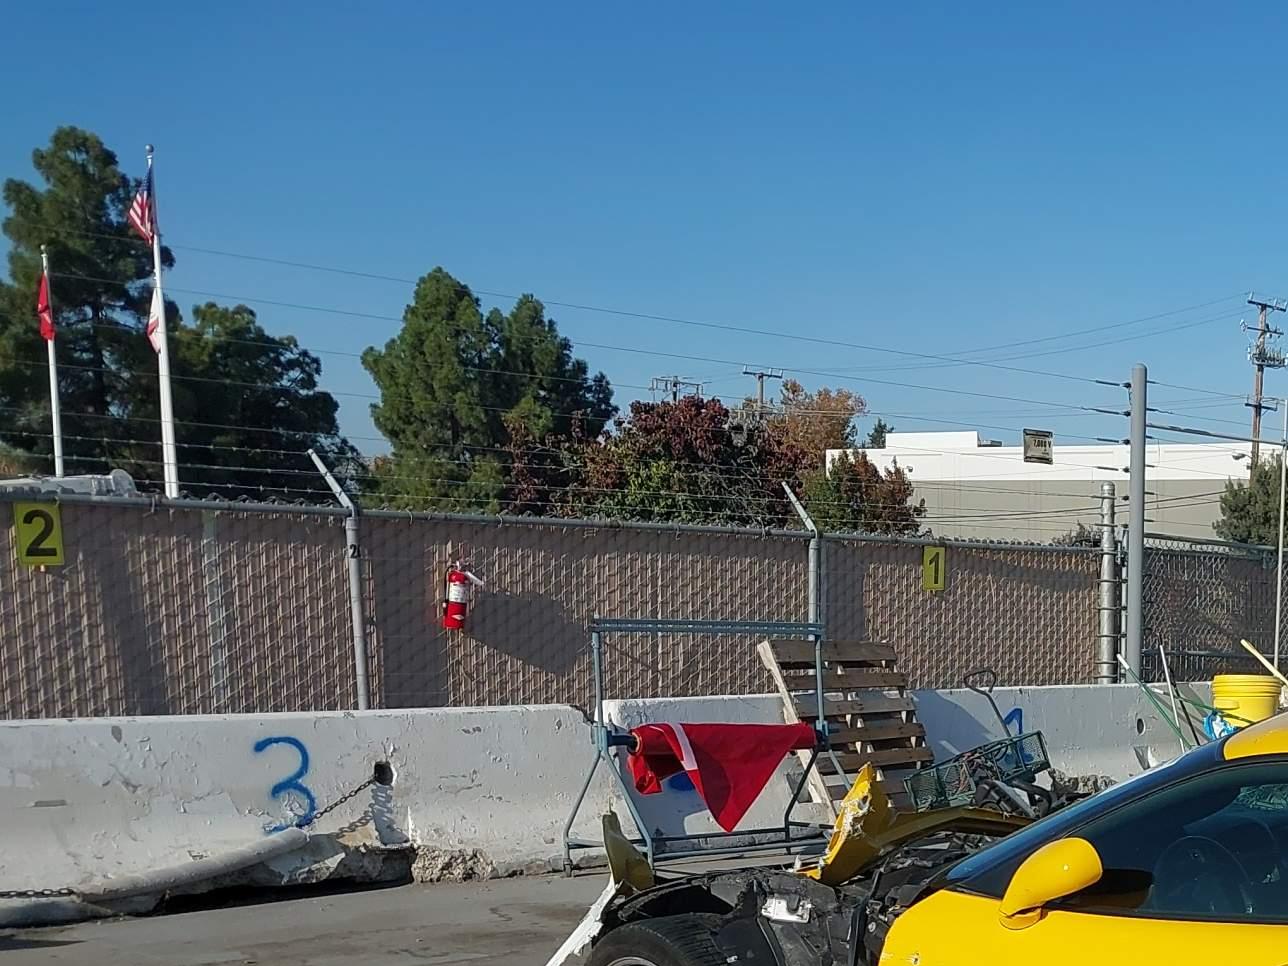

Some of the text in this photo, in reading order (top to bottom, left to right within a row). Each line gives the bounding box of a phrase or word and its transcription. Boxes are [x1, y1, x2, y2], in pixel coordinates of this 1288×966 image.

[22, 508, 58, 557] 2
[928, 551, 940, 585] 1
[253, 736, 317, 833] 3
